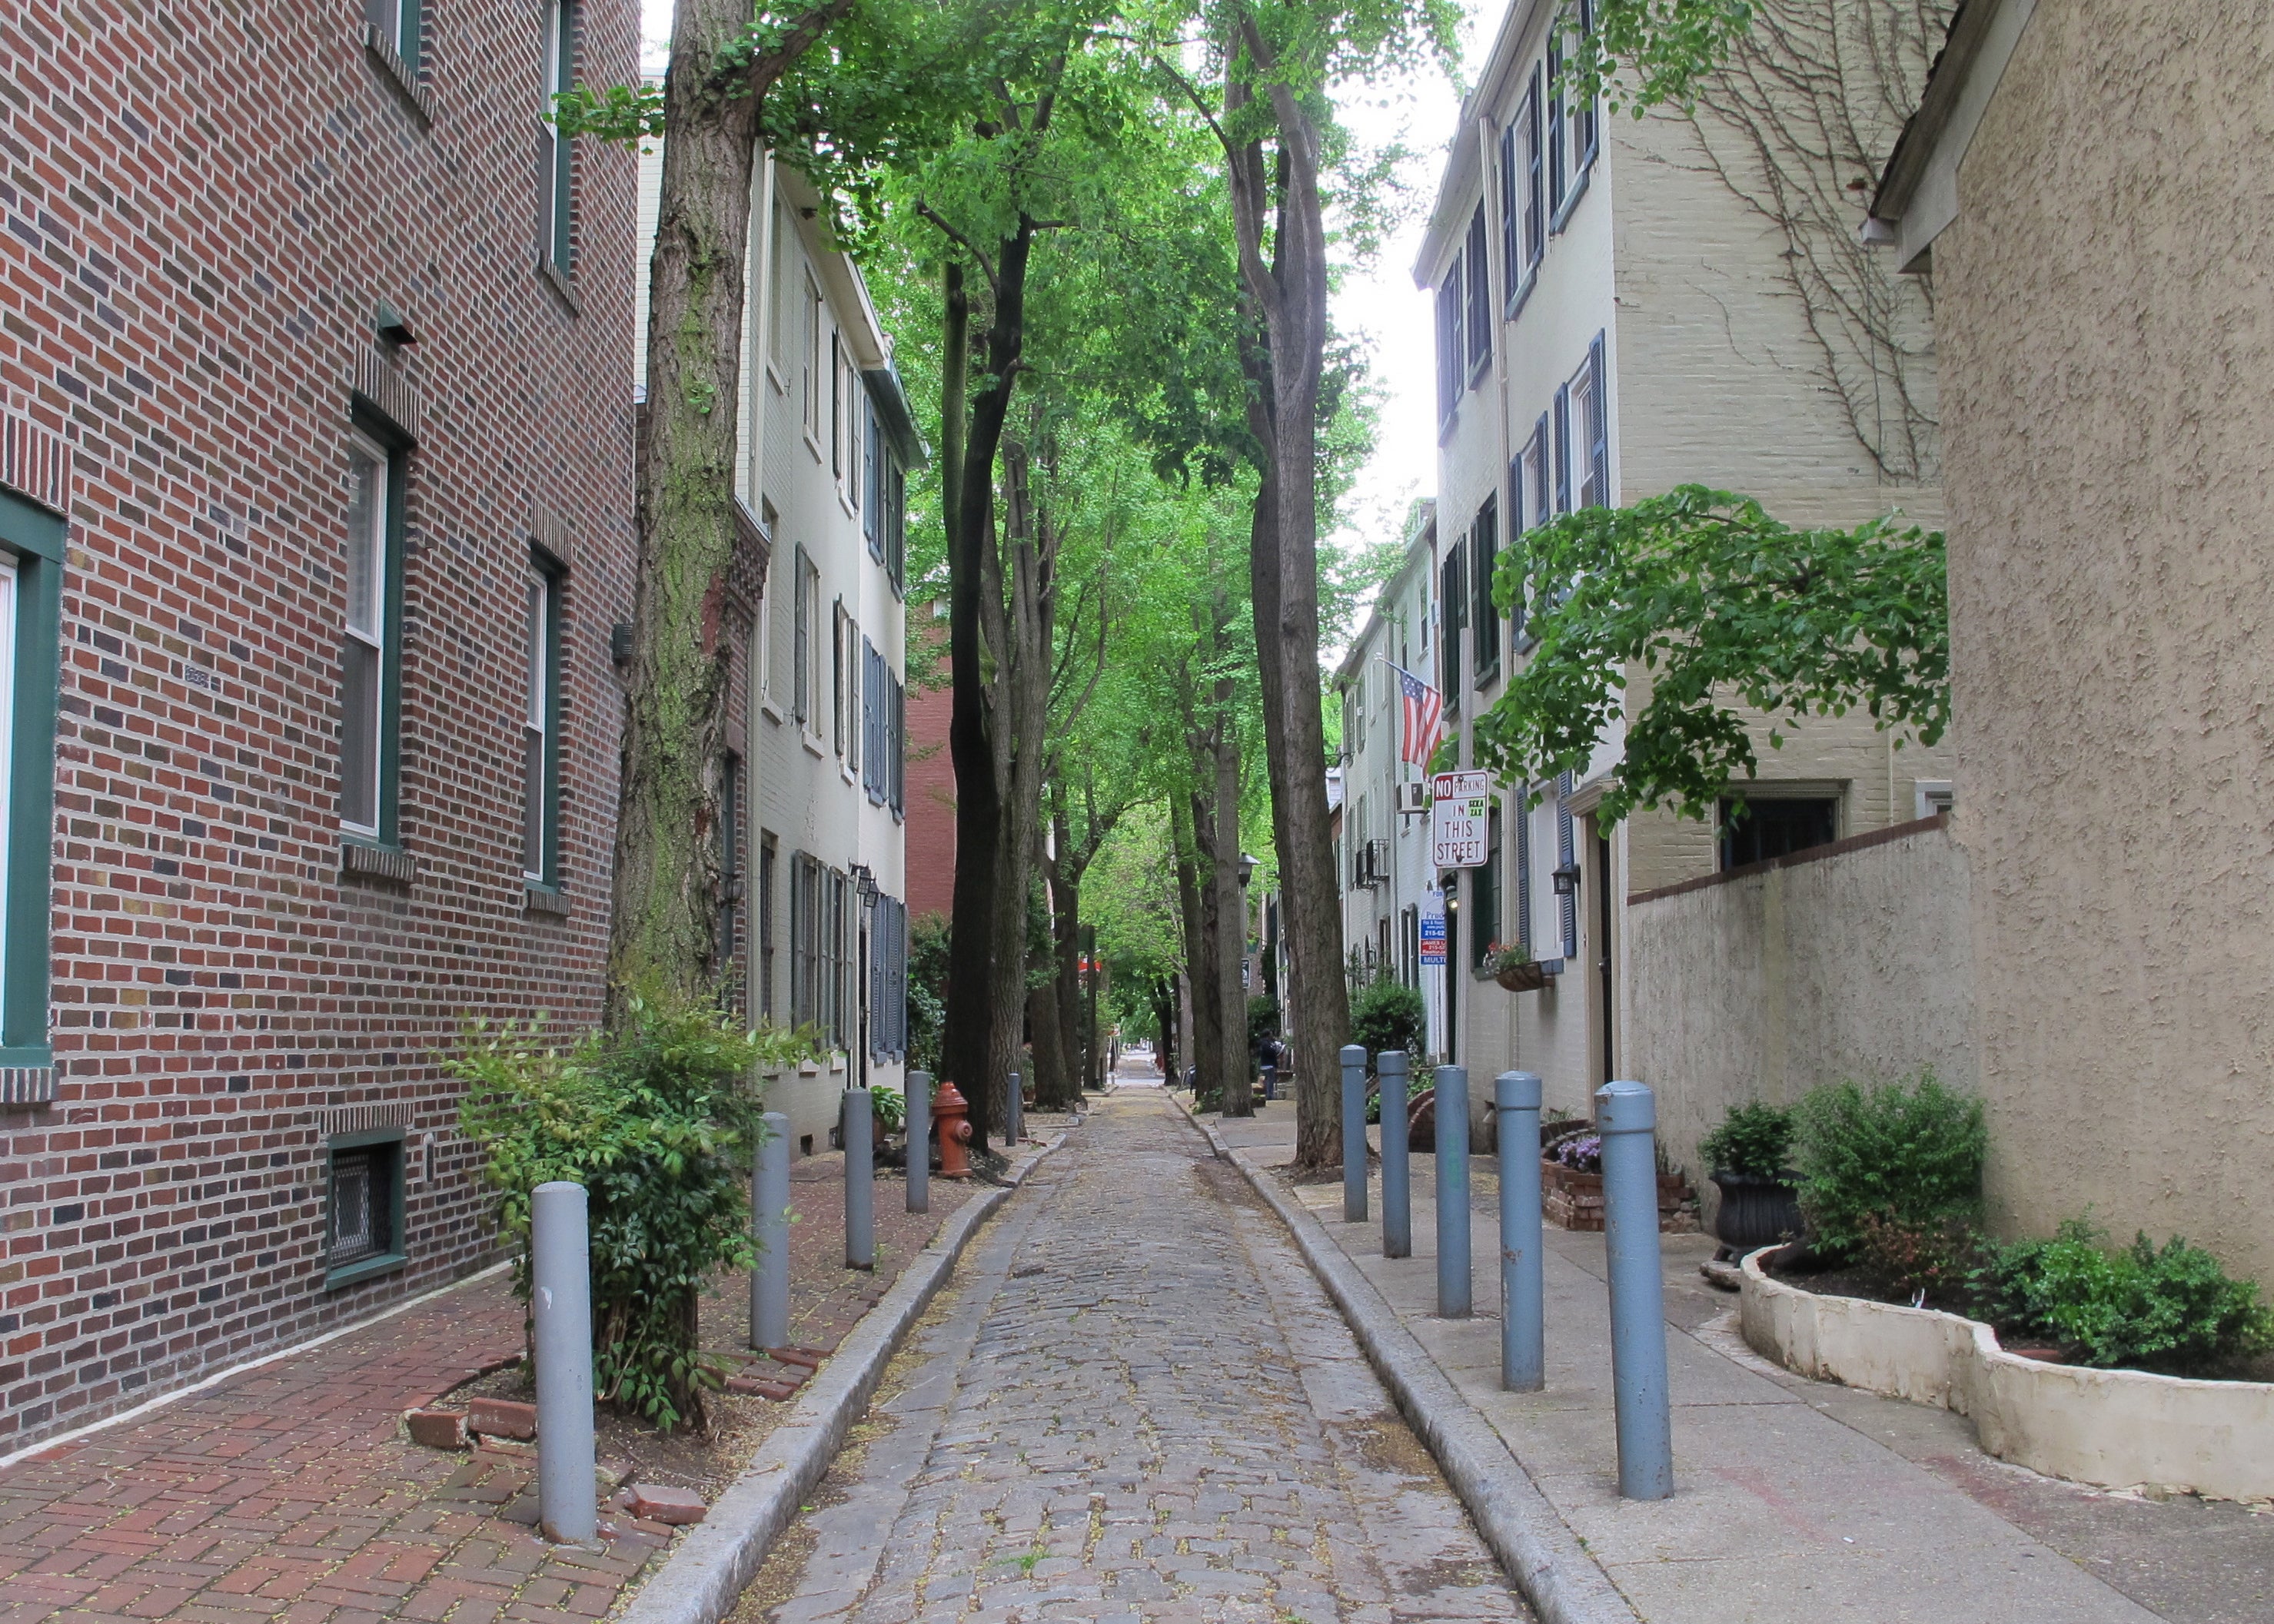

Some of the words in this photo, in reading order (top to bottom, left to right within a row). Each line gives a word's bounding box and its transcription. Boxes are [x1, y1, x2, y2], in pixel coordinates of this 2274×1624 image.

[1436, 779, 1451, 797] NO
[1454, 779, 1484, 792] PARKING
[1453, 805, 1464, 816] IN
[1445, 820, 1472, 839] THIS
[1437, 841, 1480, 860] STREET
